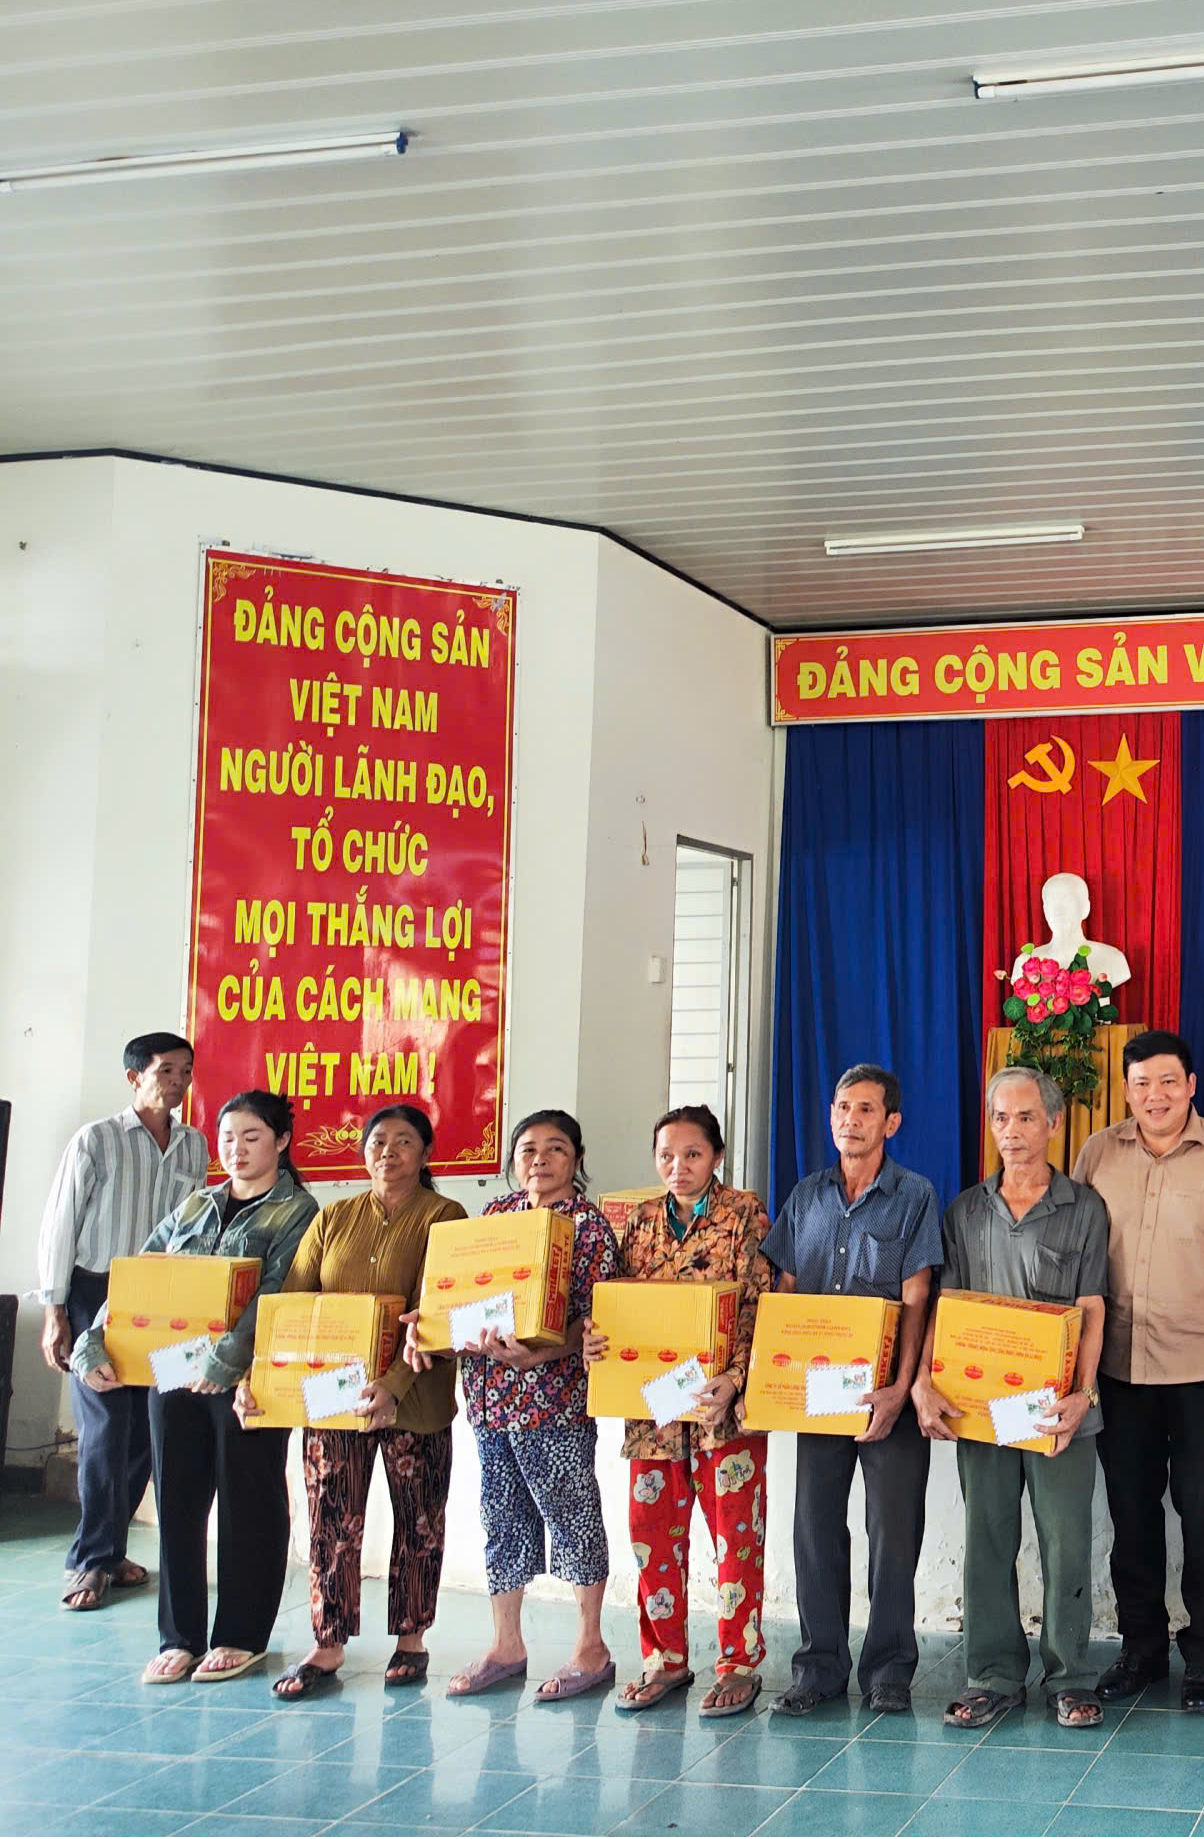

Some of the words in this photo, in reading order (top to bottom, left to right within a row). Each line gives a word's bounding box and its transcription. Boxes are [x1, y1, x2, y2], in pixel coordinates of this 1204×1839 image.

[234, 586, 325, 649] ĐẢNG
[335, 604, 421, 667] CỘNG
[431, 610, 489, 667] SẢN
[798, 646, 919, 699] ĐẢNG
[935, 644, 1060, 703] CỘNG
[1077, 632, 1168, 688] SẢN
[290, 672, 363, 736] VIỆT
[372, 687, 438, 732] NAM
[220, 740, 323, 796] NGƯỜI
[335, 746, 417, 802] LÃNH
[426, 773, 494, 817] ĐẠO,
[292, 807, 333, 871] TỔ
[342, 822, 428, 876] CHỨC
[234, 900, 296, 958] MỌI
[307, 886, 415, 948] THẮNG
[425, 902, 472, 961] LỢI
[218, 960, 286, 1022] CỦA
[295, 965, 384, 1022] CÁCH
[393, 978, 481, 1032] MẠNG
[265, 1043, 340, 1110] VIỆT
[349, 1052, 418, 1095] NAM
[427, 1052, 436, 1094] !
